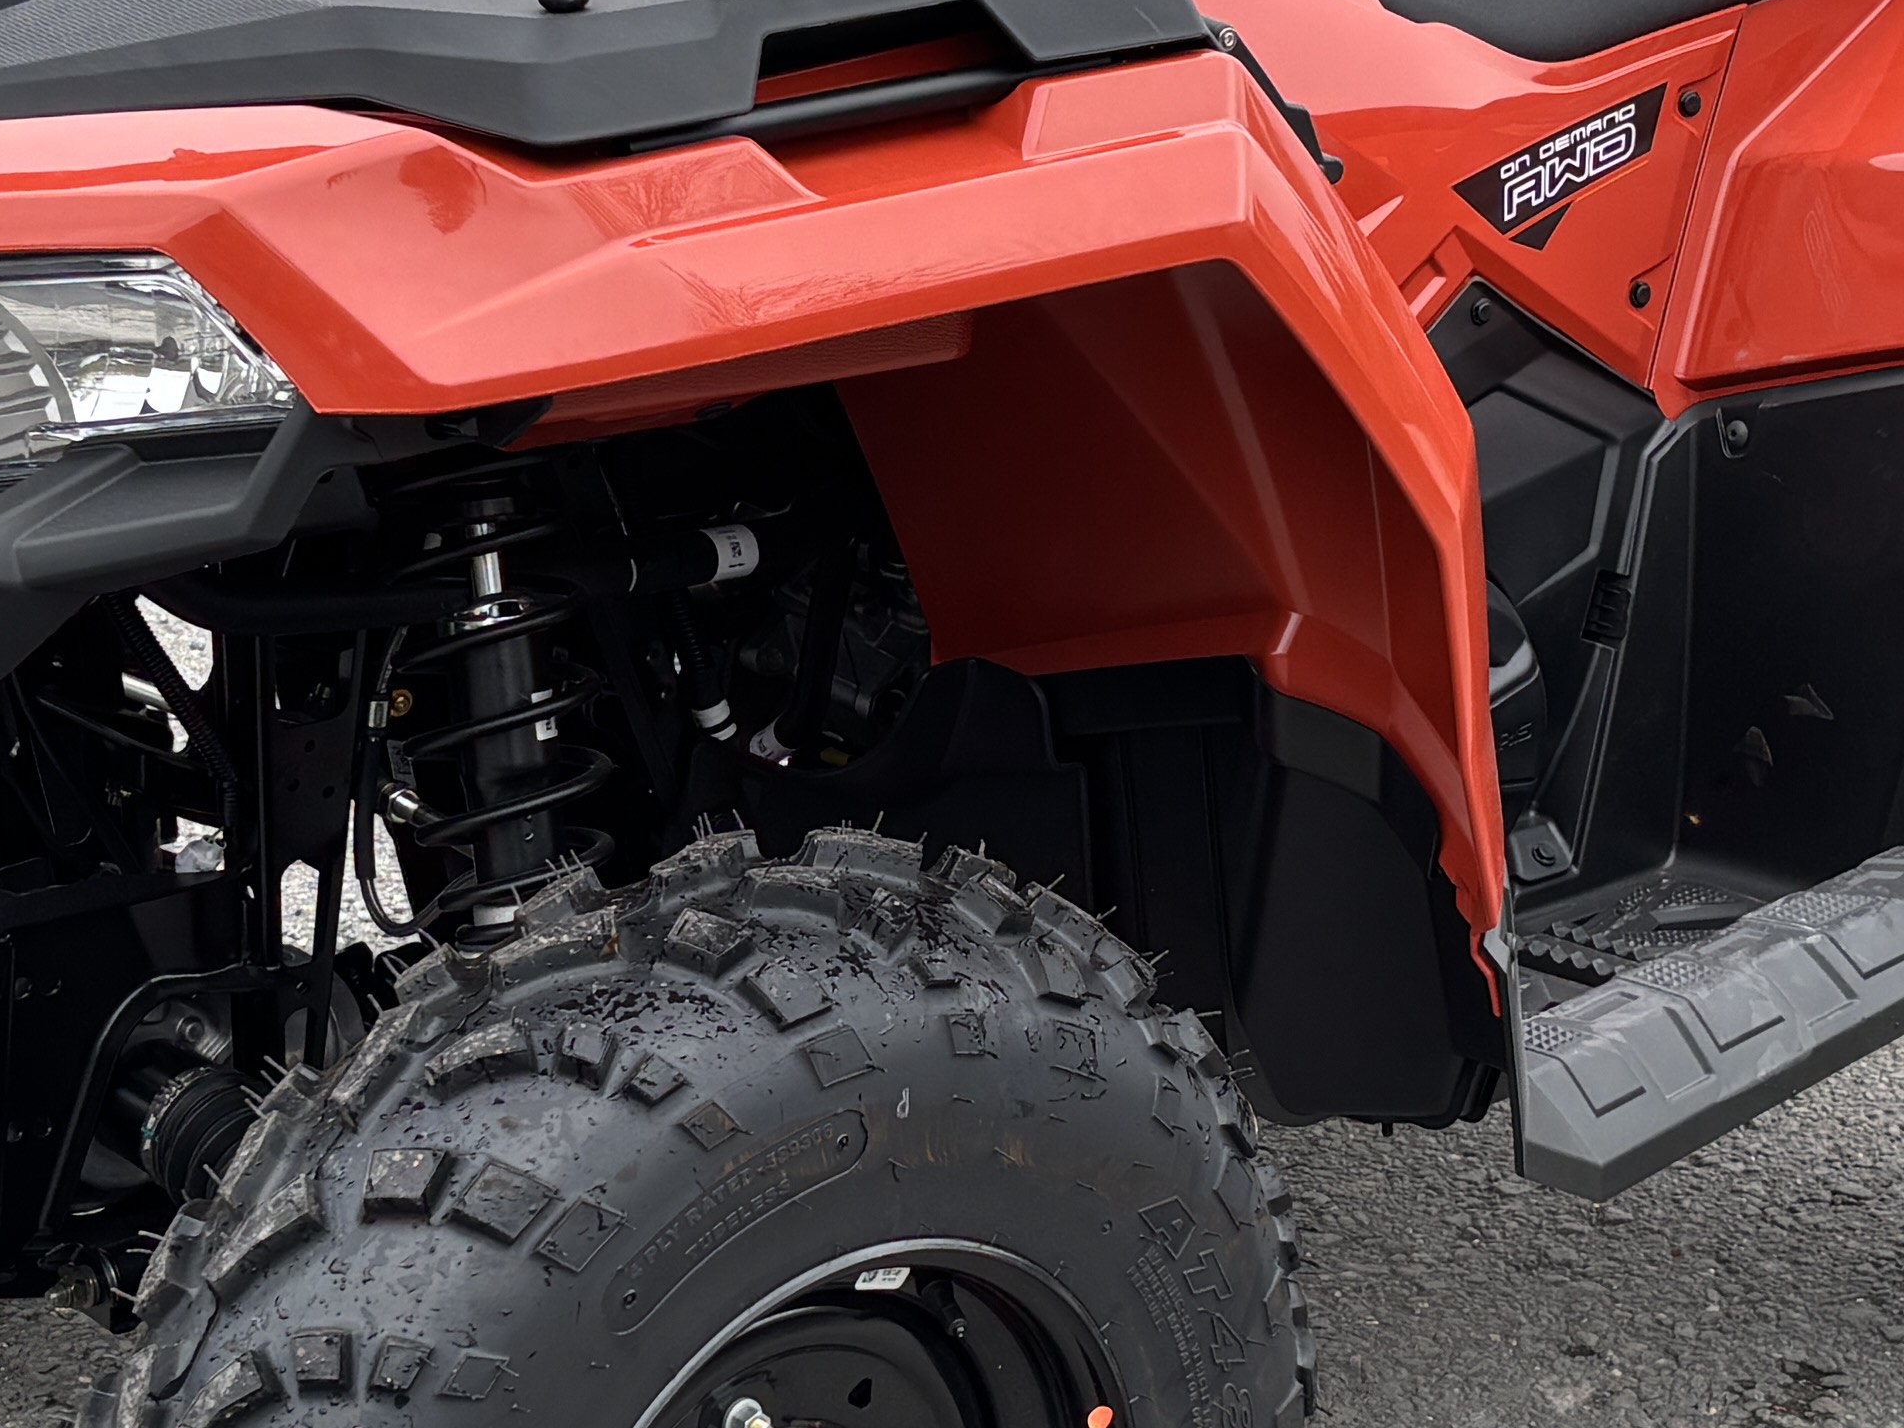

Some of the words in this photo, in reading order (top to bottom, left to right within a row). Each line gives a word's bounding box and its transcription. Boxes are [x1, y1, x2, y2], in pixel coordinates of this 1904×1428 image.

[1539, 103, 1636, 160] DEMAND
[1503, 122, 1636, 222] AWD
[643, 1220, 686, 1266] PLY
[685, 1177, 792, 1260] TUBELESS
